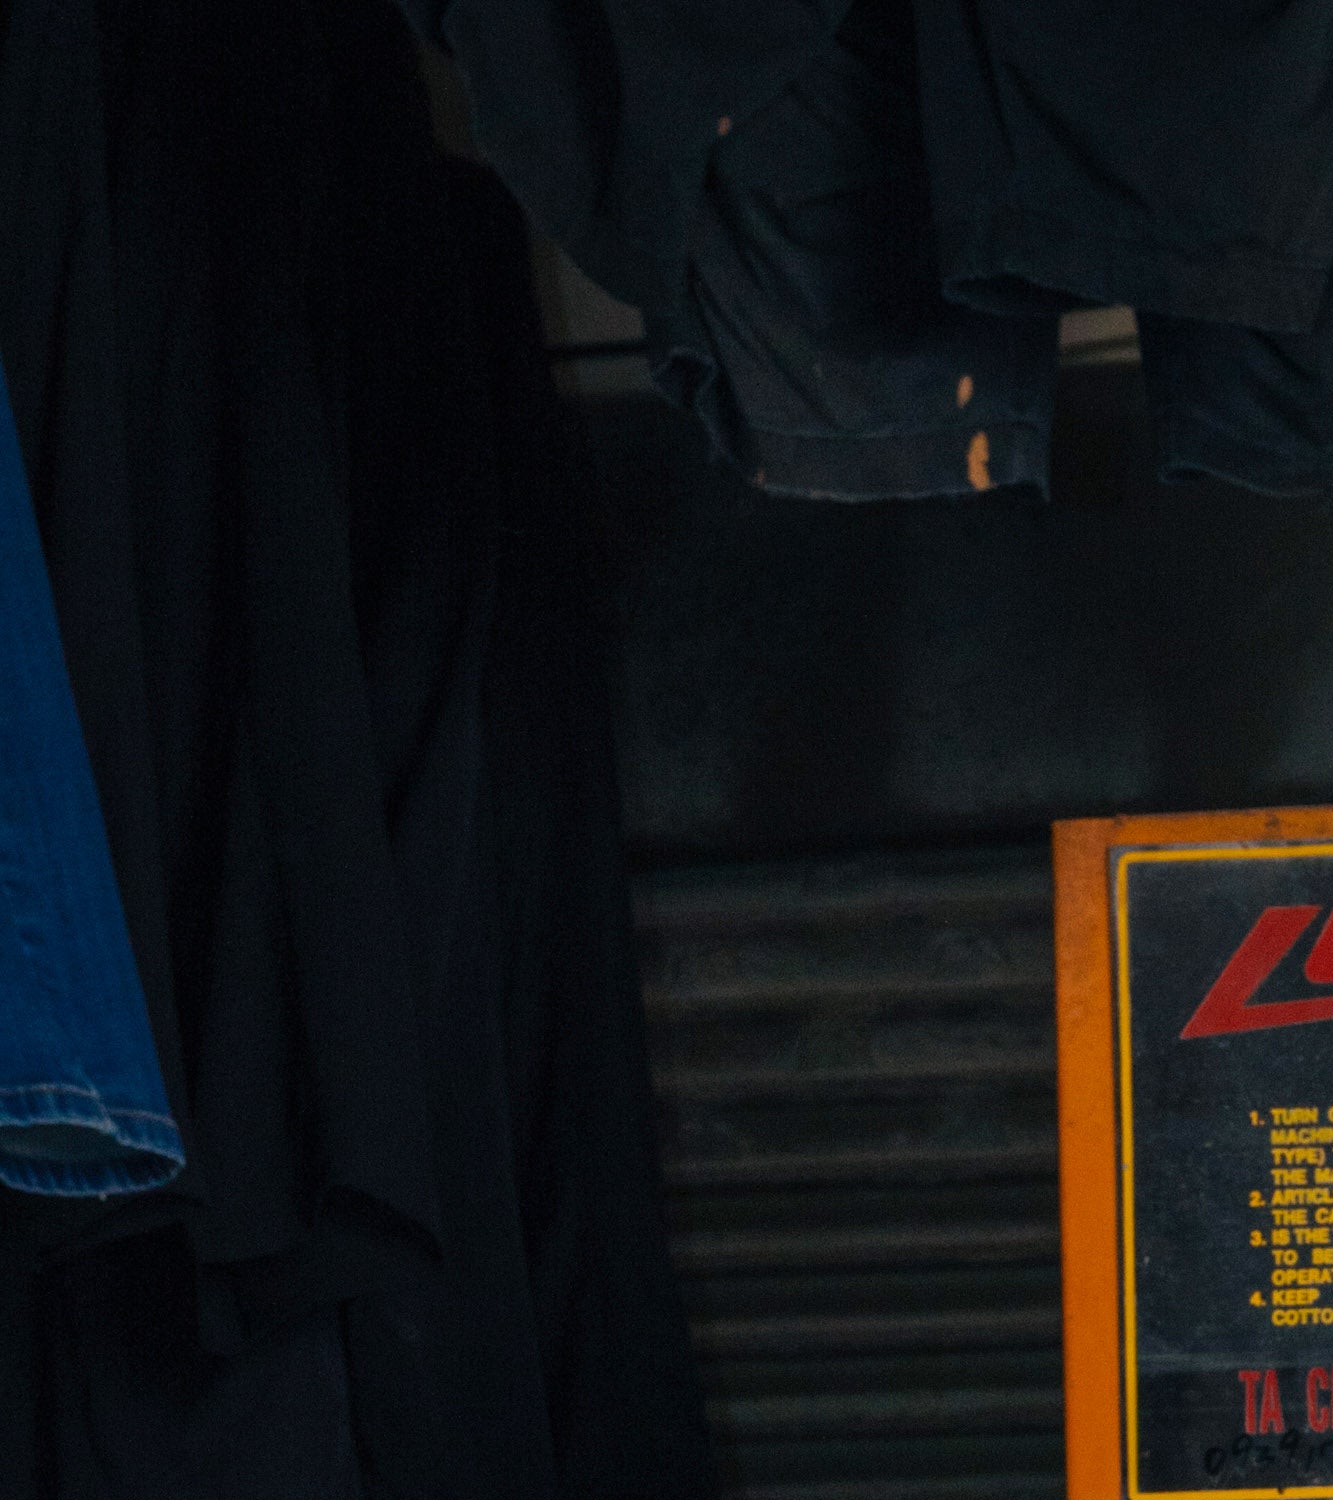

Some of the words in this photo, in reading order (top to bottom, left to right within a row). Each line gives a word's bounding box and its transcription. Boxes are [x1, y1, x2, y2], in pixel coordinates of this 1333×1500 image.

[1250, 1111, 1263, 1125] 1.
[1271, 1107, 1318, 1125] TURN
[1272, 1147, 1325, 1166] TYPE)
[1272, 1168, 1307, 1185] THE
[1249, 1190, 1265, 1207] 2.
[1272, 1208, 1307, 1225] THE
[1250, 1230, 1266, 1247] 3.
[1271, 1228, 1290, 1246] IS
[1296, 1226, 1329, 1244] THE
[1272, 1249, 1298, 1266] TO
[1250, 1291, 1265, 1307] 4.
[1271, 1288, 1319, 1306] KEEP
[1238, 1368, 1285, 1435] TA
